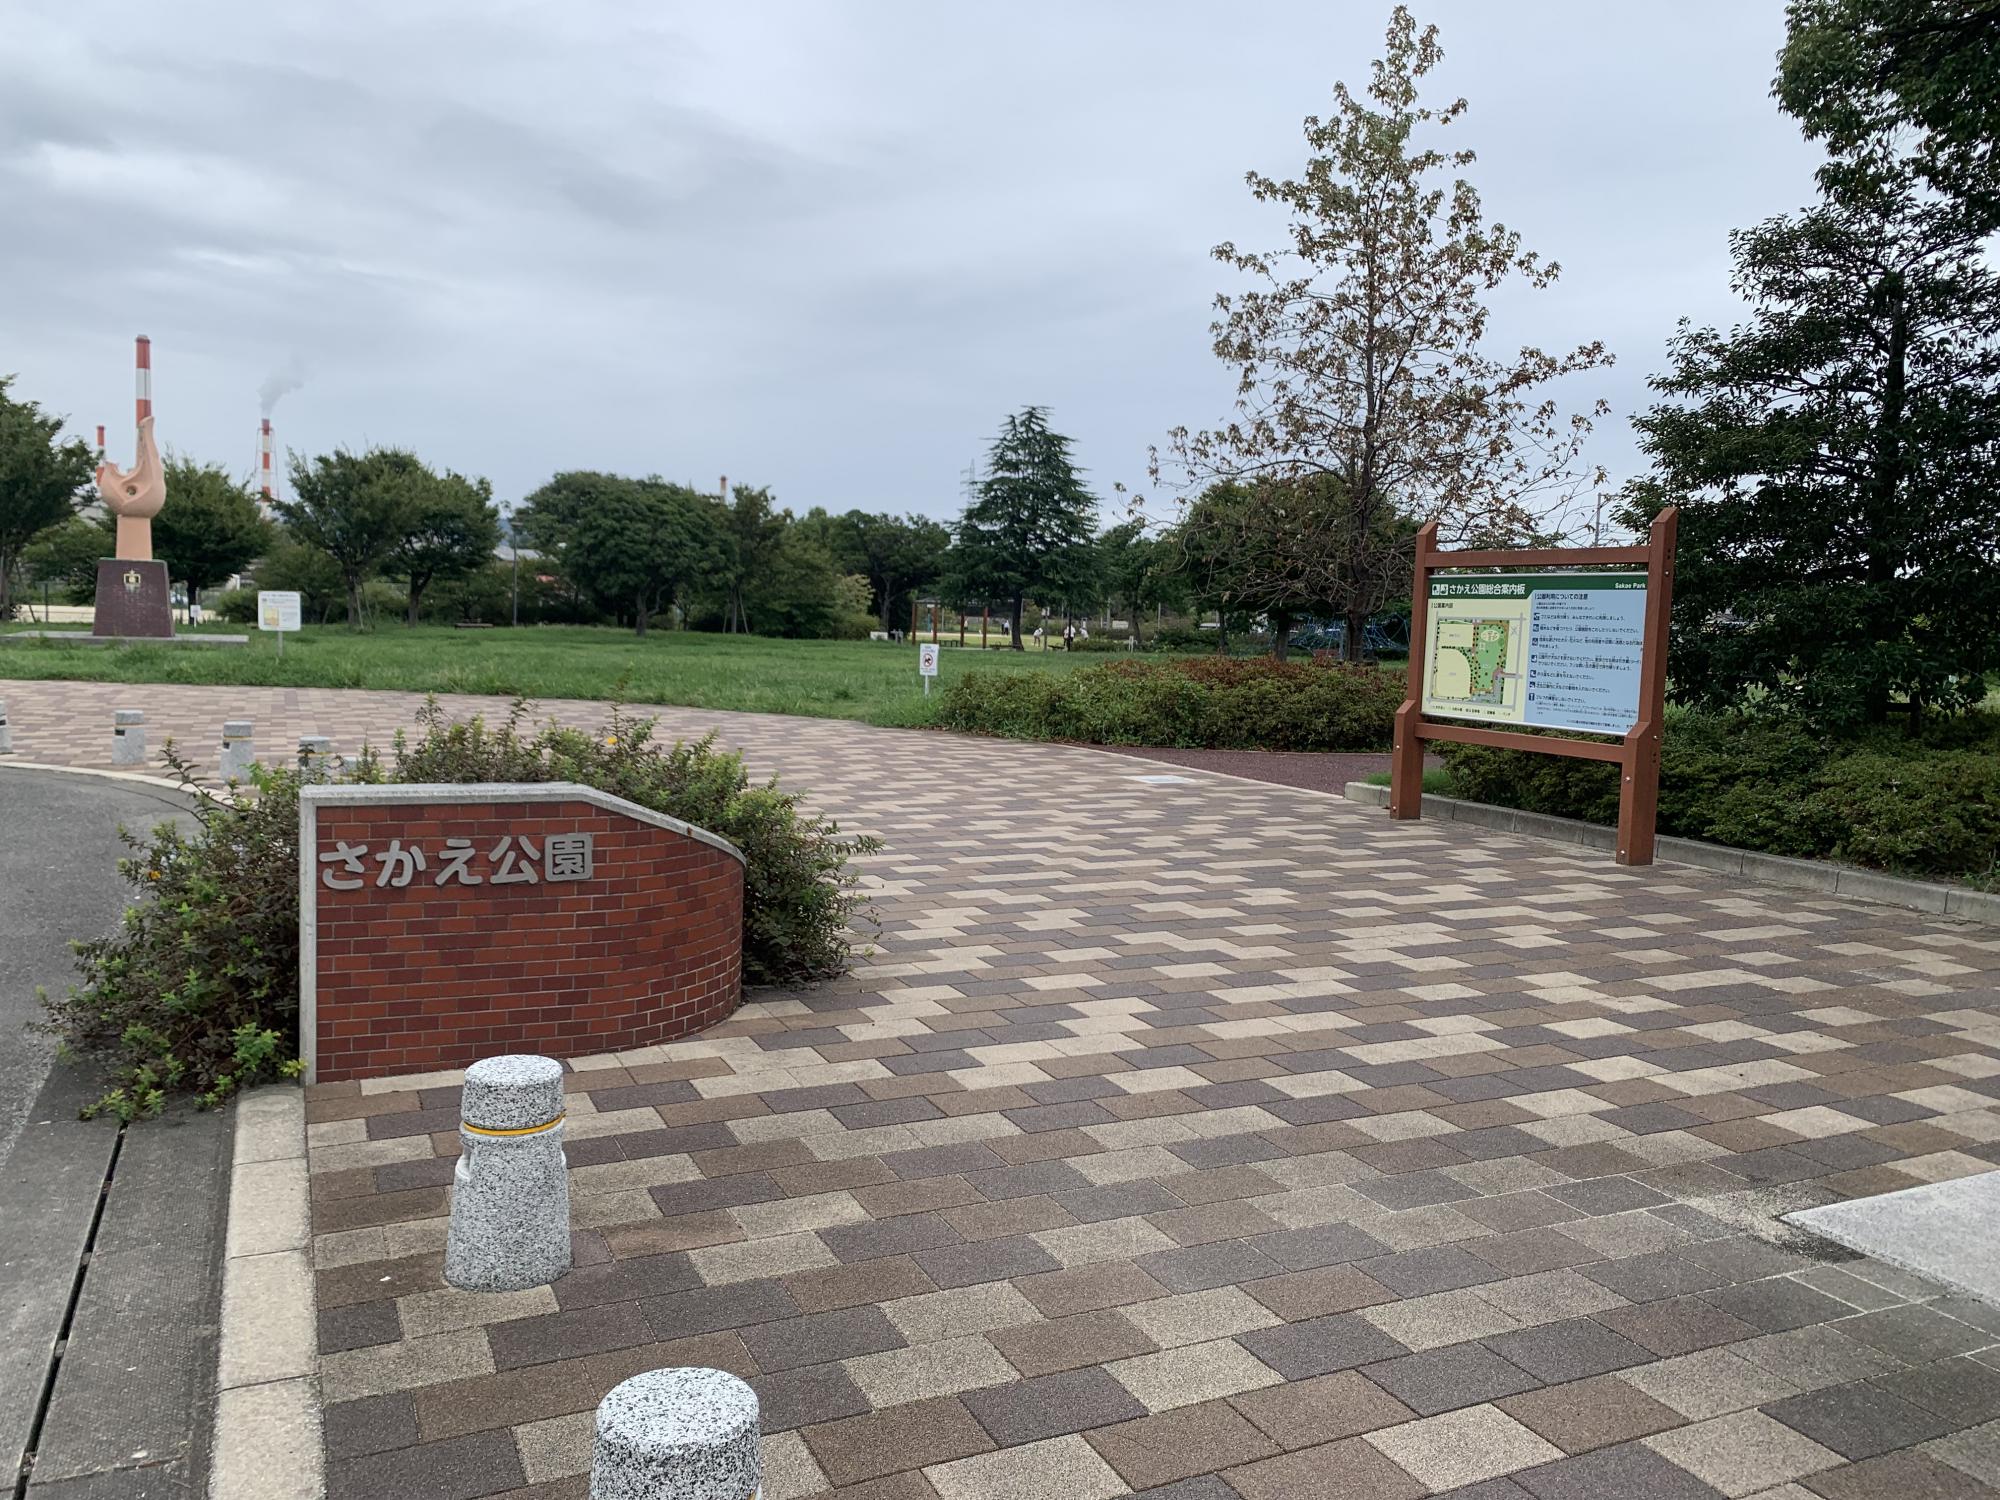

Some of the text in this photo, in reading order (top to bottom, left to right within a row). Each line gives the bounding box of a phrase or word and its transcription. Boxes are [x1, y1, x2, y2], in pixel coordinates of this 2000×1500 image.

[1449, 583, 1526, 595] さかえ公園総合案内板
[319, 832, 594, 891] さかえ公園
